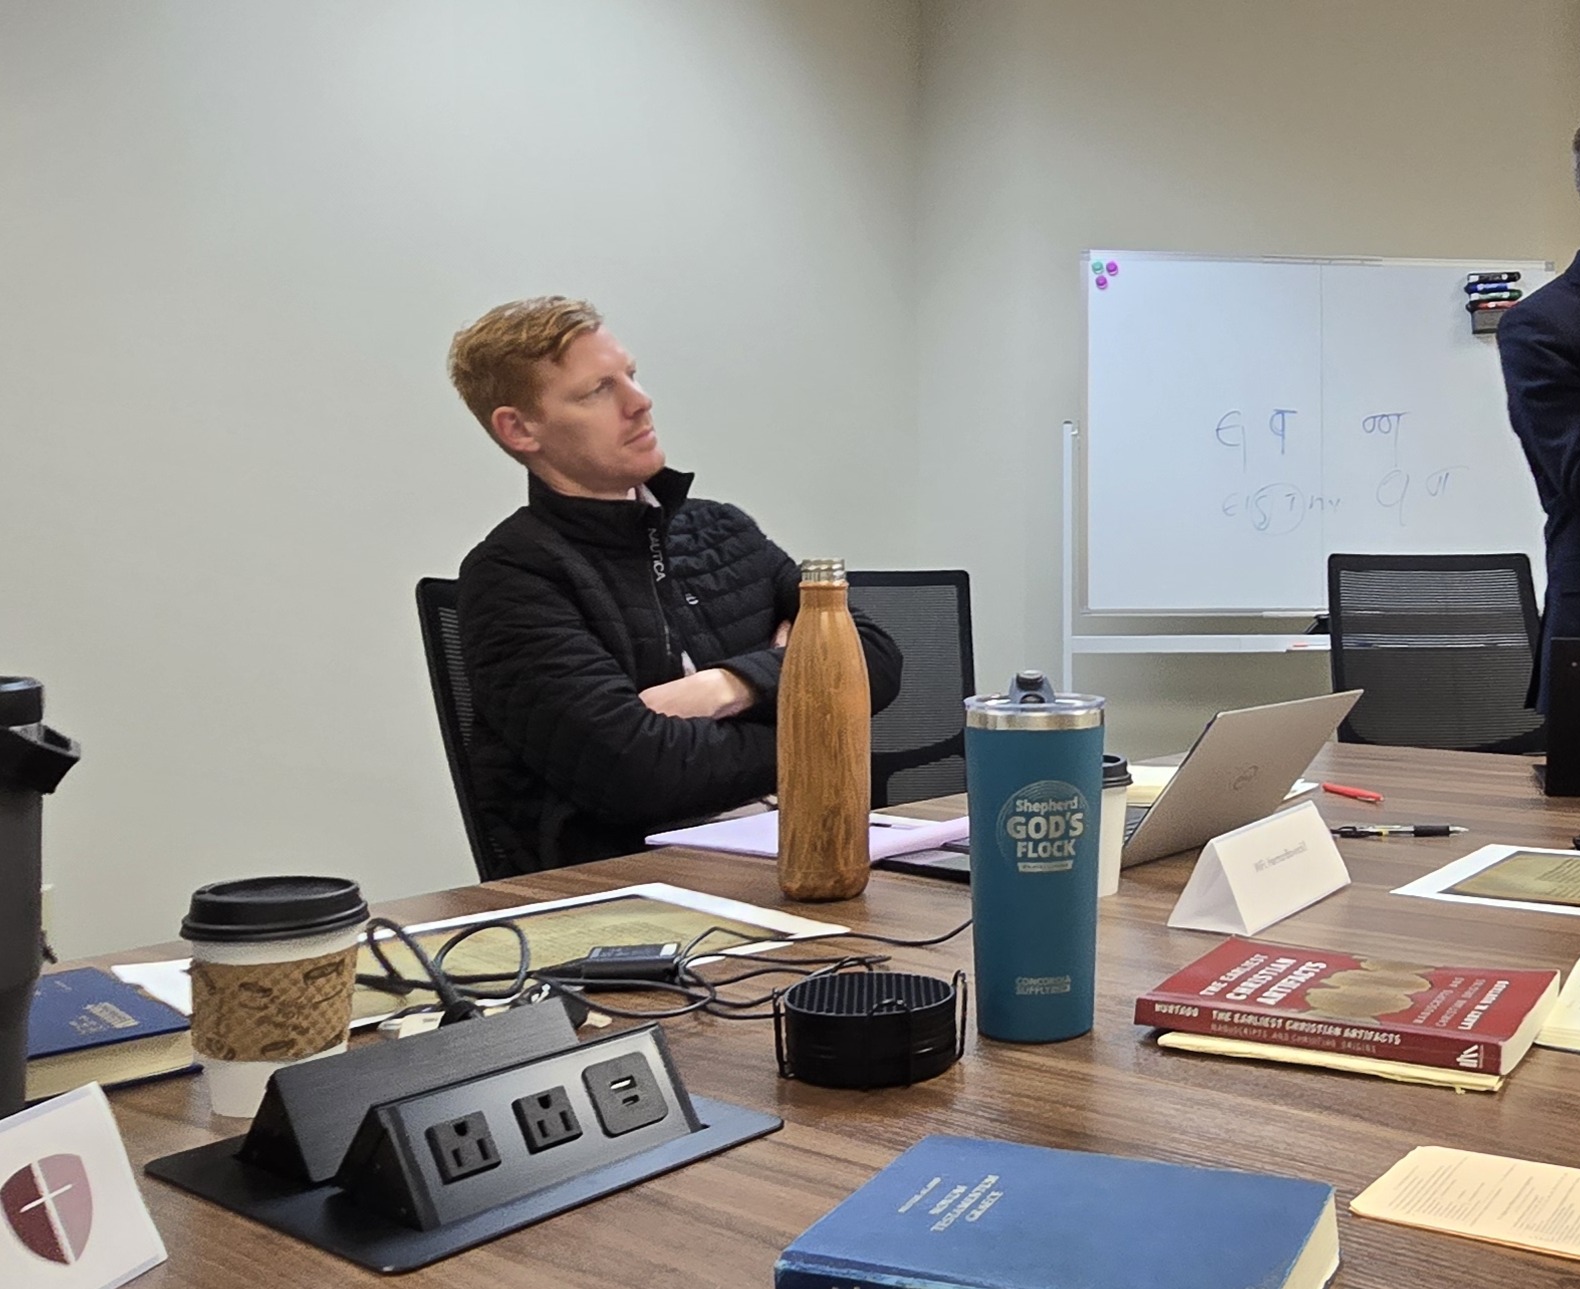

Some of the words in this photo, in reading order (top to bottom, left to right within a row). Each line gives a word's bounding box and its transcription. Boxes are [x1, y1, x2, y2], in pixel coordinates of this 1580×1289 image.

[648, 527, 667, 582] NAUTICA
[1006, 812, 1084, 839] GOD'S
[1015, 796, 1079, 815] Shepherd
[1016, 838, 1077, 858] FLOCK
[1200, 980, 1228, 997] THE
[1220, 953, 1269, 981] EARLIEST
[1225, 957, 1297, 1001] CHRISTIAN
[1256, 960, 1327, 1006] ARTIFACTS
[1154, 1002, 1199, 1018] HURTADO
[1211, 1009, 1232, 1023] THE
[1233, 1012, 1284, 1030] EARLIEST
[1285, 1018, 1342, 1037] CHRISTIAN
[1343, 1026, 1402, 1046] ARTIFACTS
